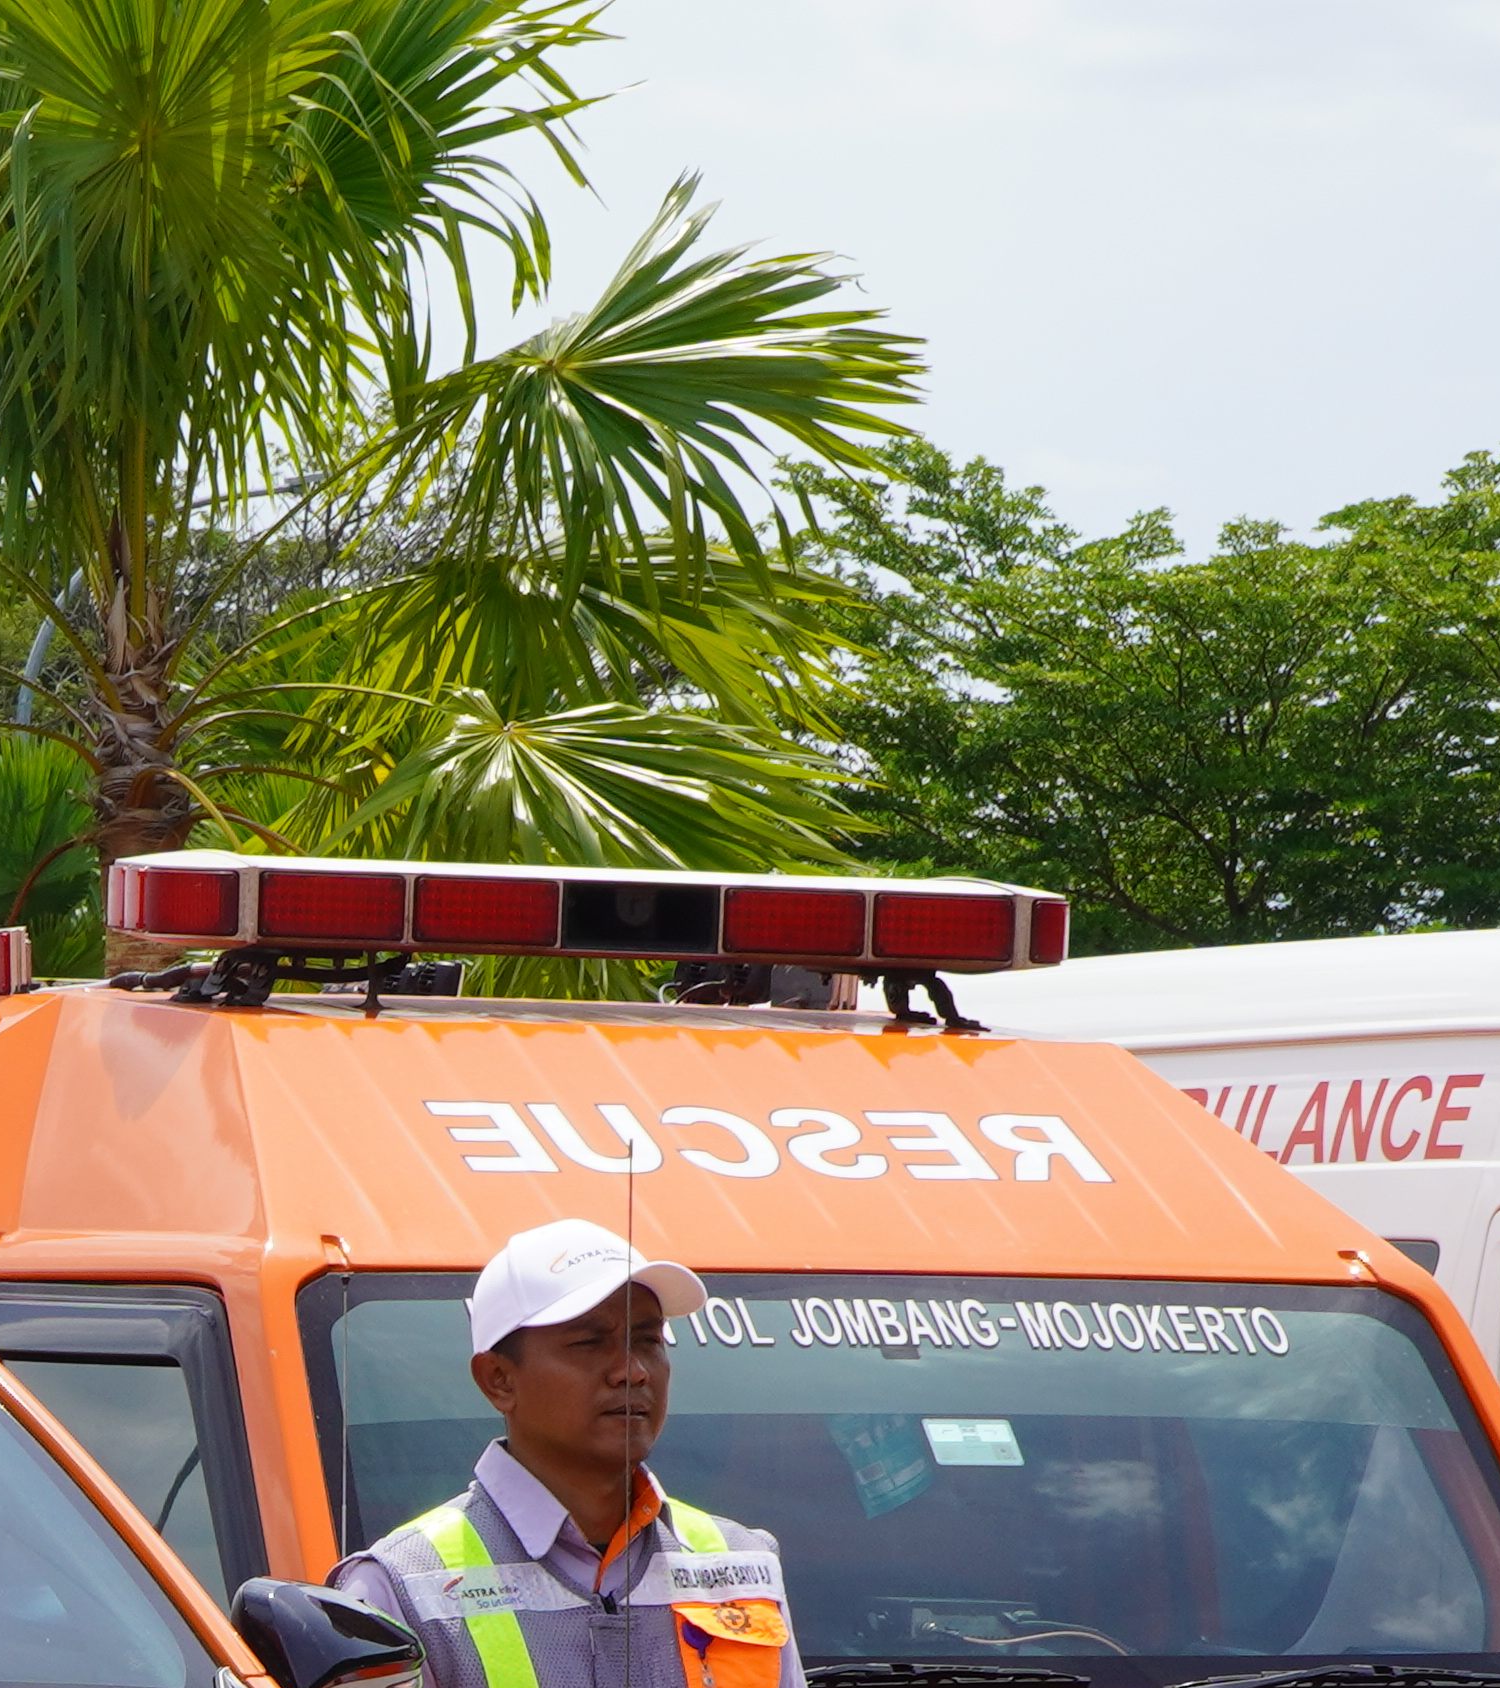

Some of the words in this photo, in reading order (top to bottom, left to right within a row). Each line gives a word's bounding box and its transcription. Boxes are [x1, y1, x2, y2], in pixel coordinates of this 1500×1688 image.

[1181, 1074, 1485, 1165] ULANCE
[790, 1297, 1290, 1356] JOMBANG-MOJOKERTO
[461, 1587, 497, 1600] ASTRA
